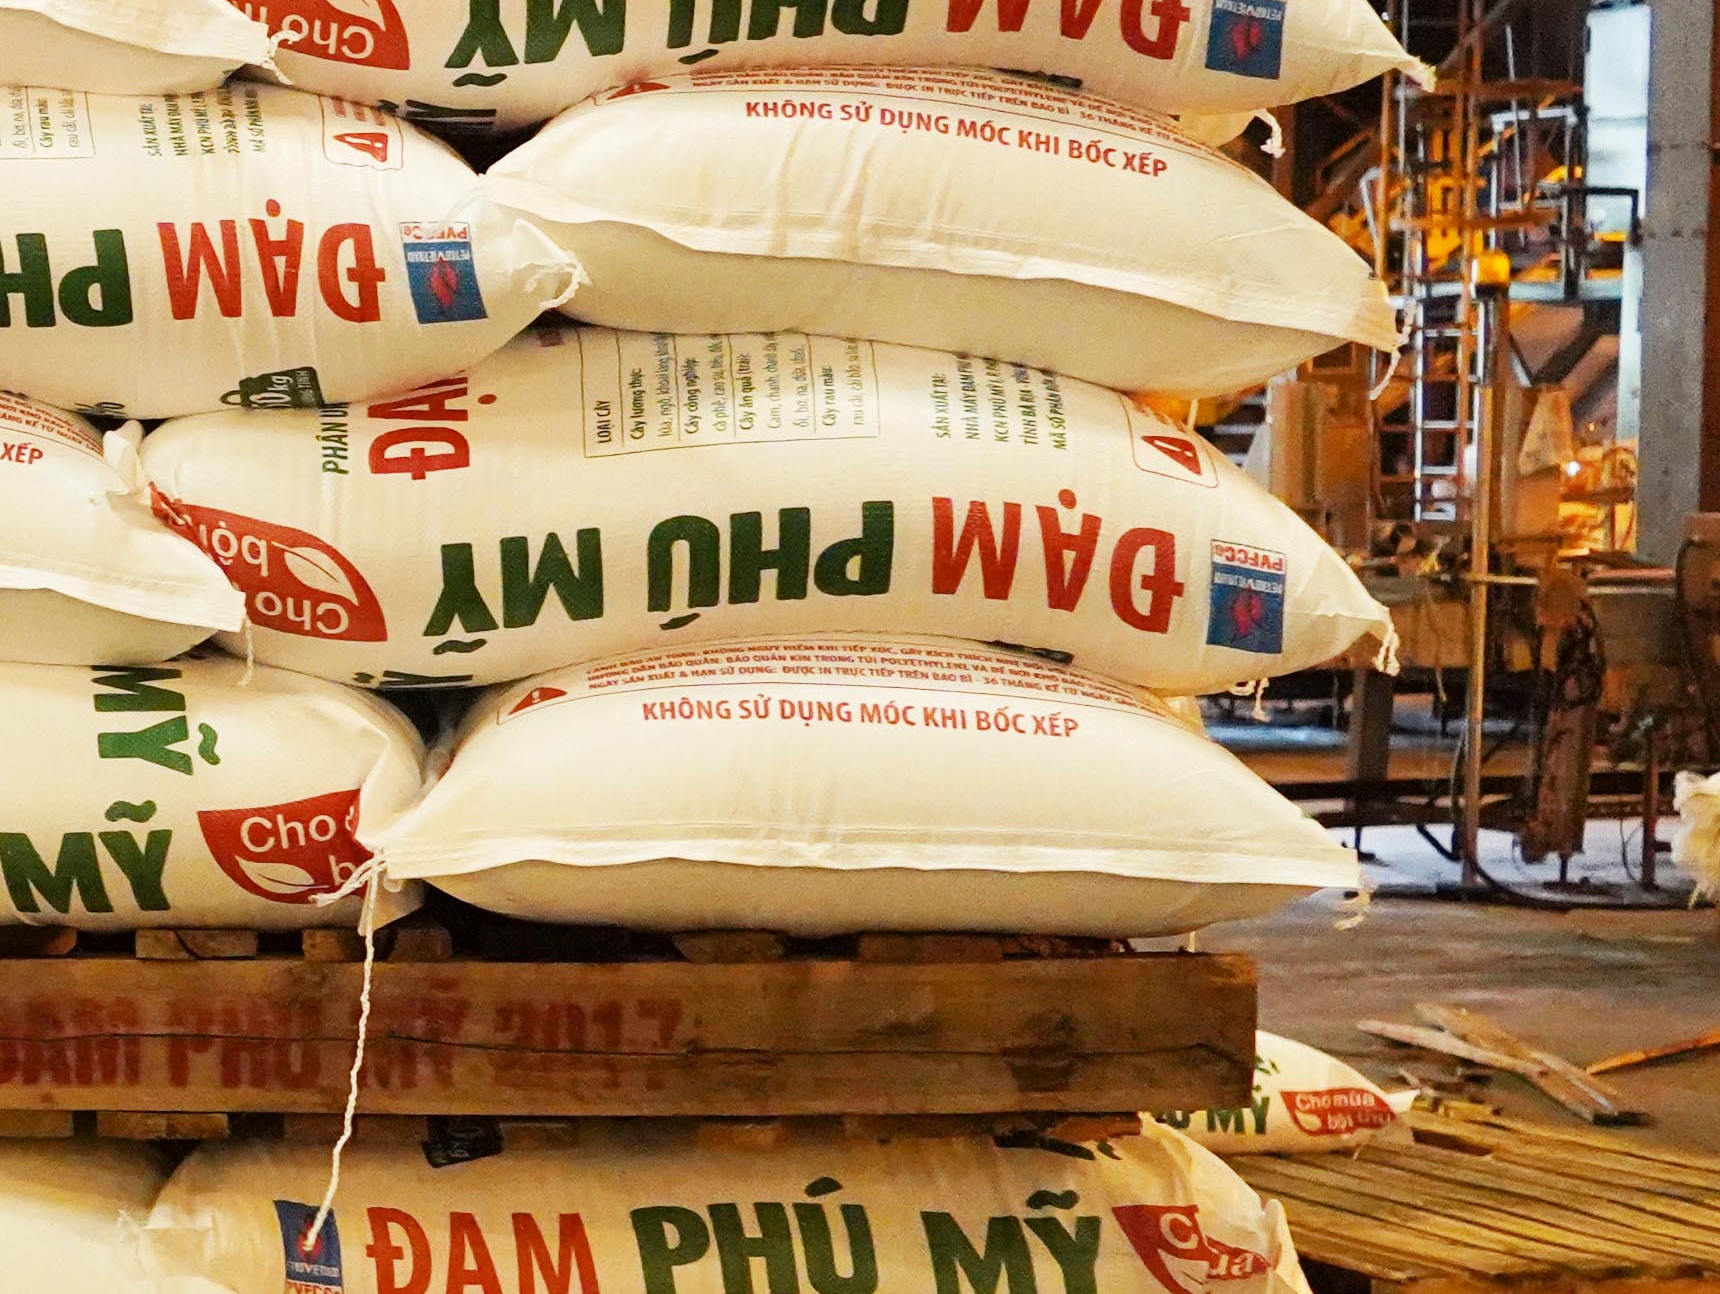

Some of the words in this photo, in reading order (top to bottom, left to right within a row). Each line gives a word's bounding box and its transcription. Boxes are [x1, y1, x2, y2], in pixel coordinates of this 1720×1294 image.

[746, 100, 832, 119] KHÔNG
[840, 102, 874, 123] SỬ
[880, 108, 949, 136] DỤNG
[957, 118, 1010, 147] MÓC
[1018, 131, 1061, 156] KHI
[1068, 139, 1117, 168] BỐC
[1121, 150, 1169, 178] XẾP
[157, 198, 386, 324] ĐẠM
[0, 442, 44, 466] XẾP
[422, 527, 604, 656] MỸ
[647, 500, 894, 631] PHÚ
[931, 489, 1185, 635] ĐẠM
[258, 596, 351, 636] Cho
[642, 697, 731, 720] KHÔNG
[739, 694, 771, 720] SỬ
[779, 699, 852, 727] DỤNG
[860, 701, 917, 726] MÓC
[923, 707, 967, 730] KHI
[975, 707, 1027, 734] BỐC
[1031, 711, 1079, 737] XẾP
[239, 811, 338, 854] Cho
